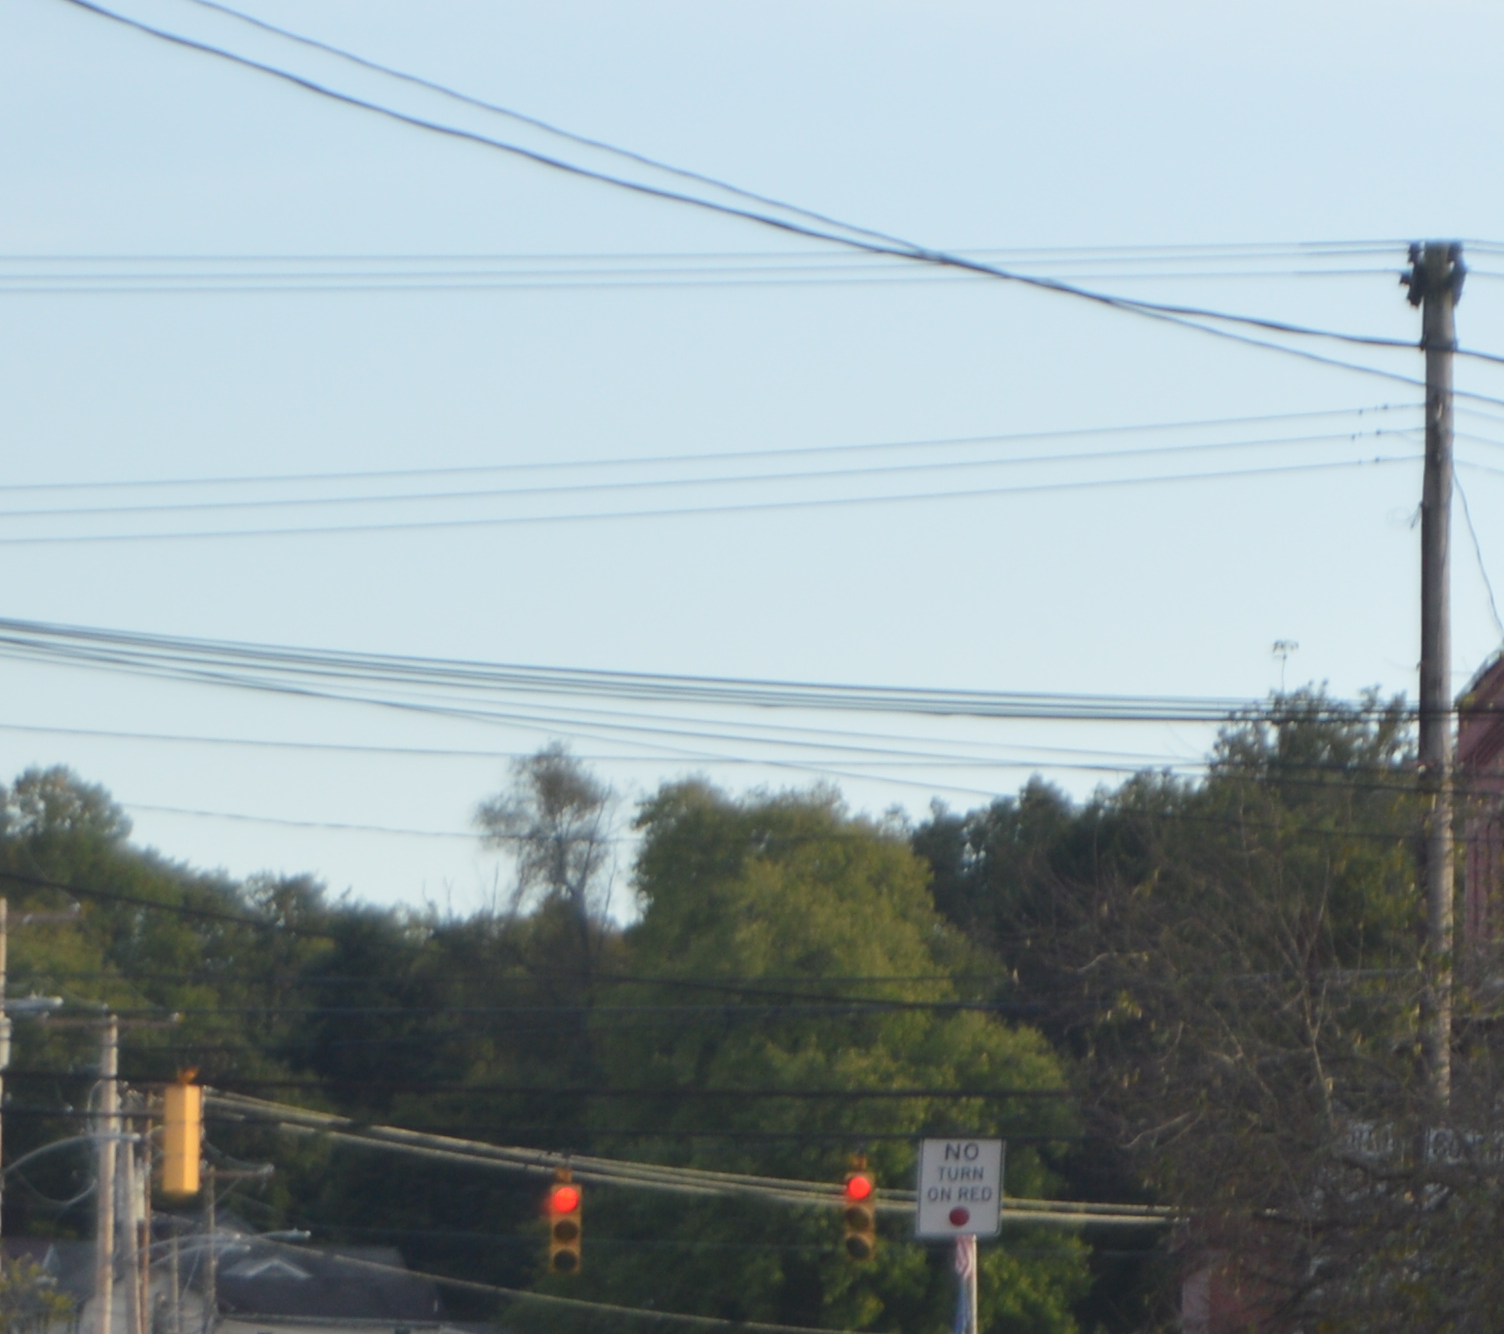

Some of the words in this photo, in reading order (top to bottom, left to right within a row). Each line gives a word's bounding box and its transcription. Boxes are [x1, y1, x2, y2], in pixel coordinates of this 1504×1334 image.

[945, 1141, 979, 1161] NO
[938, 1167, 984, 1181] TURN
[928, 1187, 952, 1202] ON
[958, 1187, 992, 1202] RED
